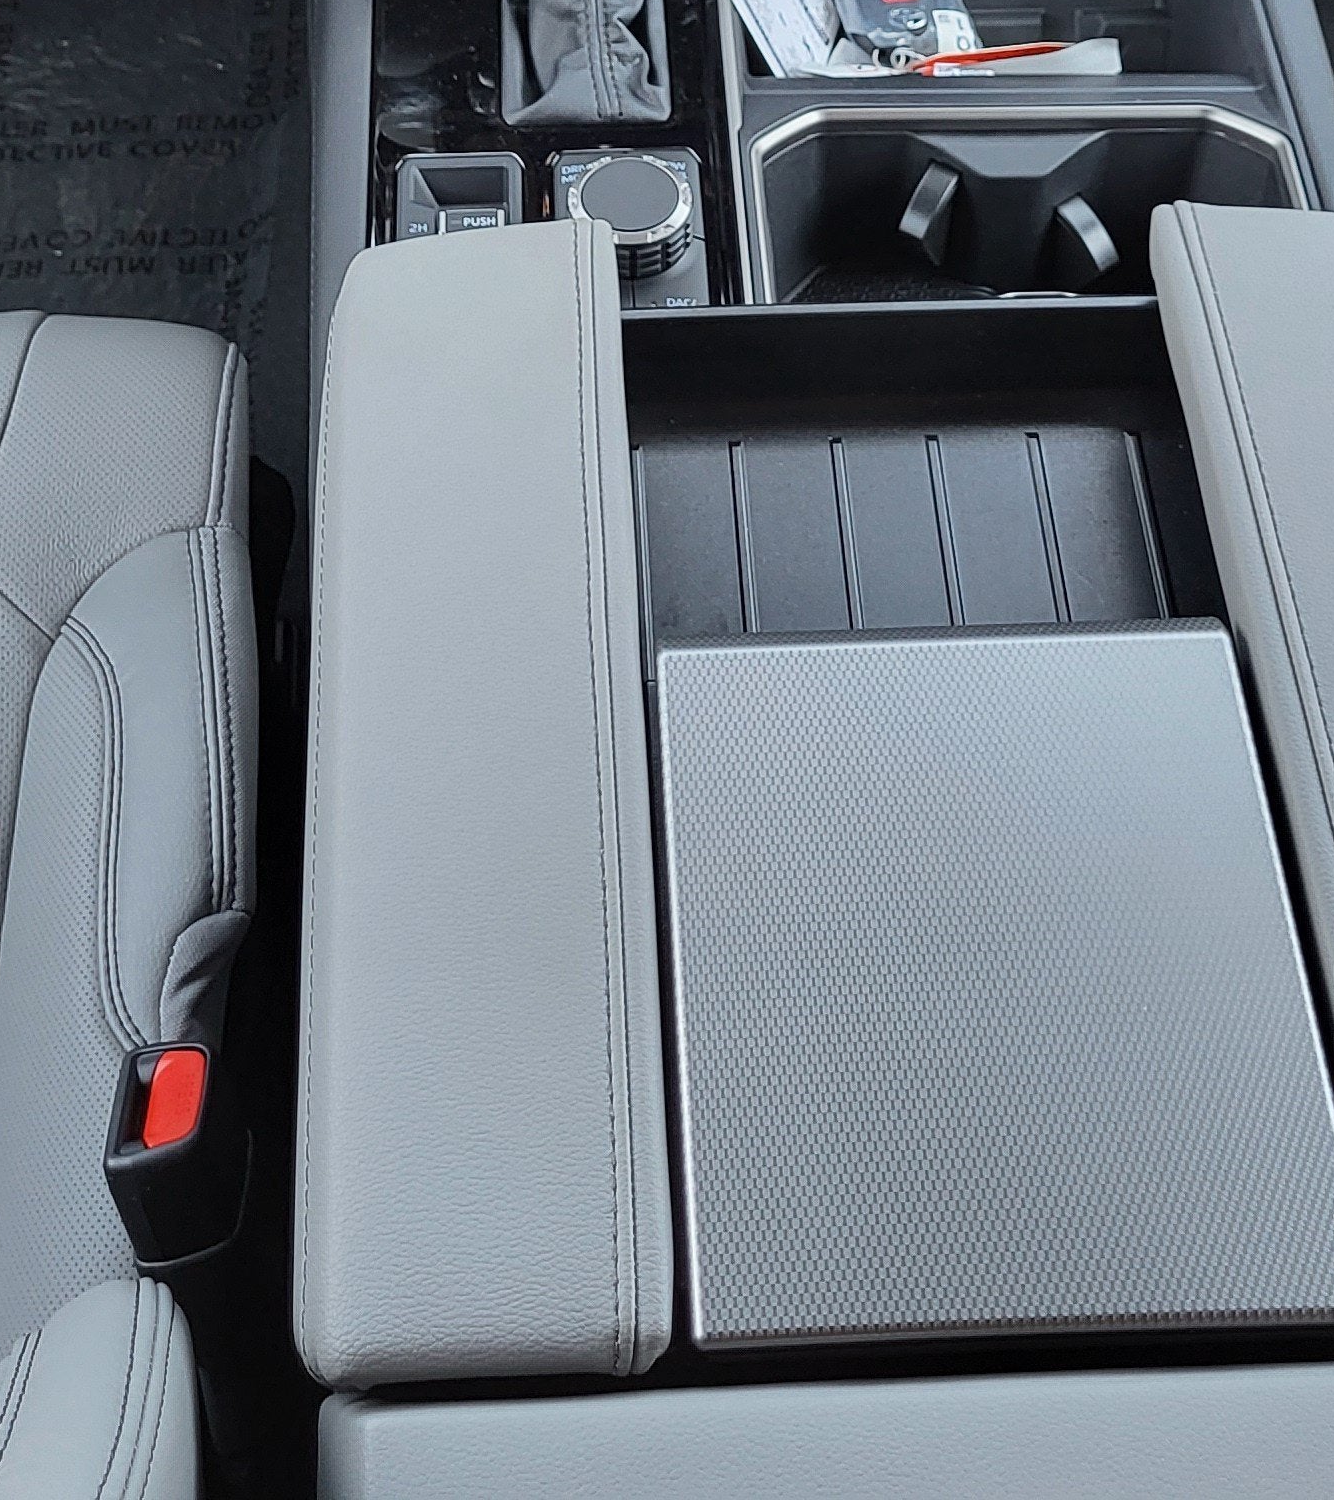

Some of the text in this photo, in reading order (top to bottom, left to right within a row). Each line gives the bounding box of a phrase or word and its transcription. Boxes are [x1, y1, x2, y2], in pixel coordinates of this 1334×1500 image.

[69, 113, 157, 136] MUST
[408, 222, 428, 234] 2H
[462, 216, 497, 228] PUSH
[67, 255, 157, 277] MUST
